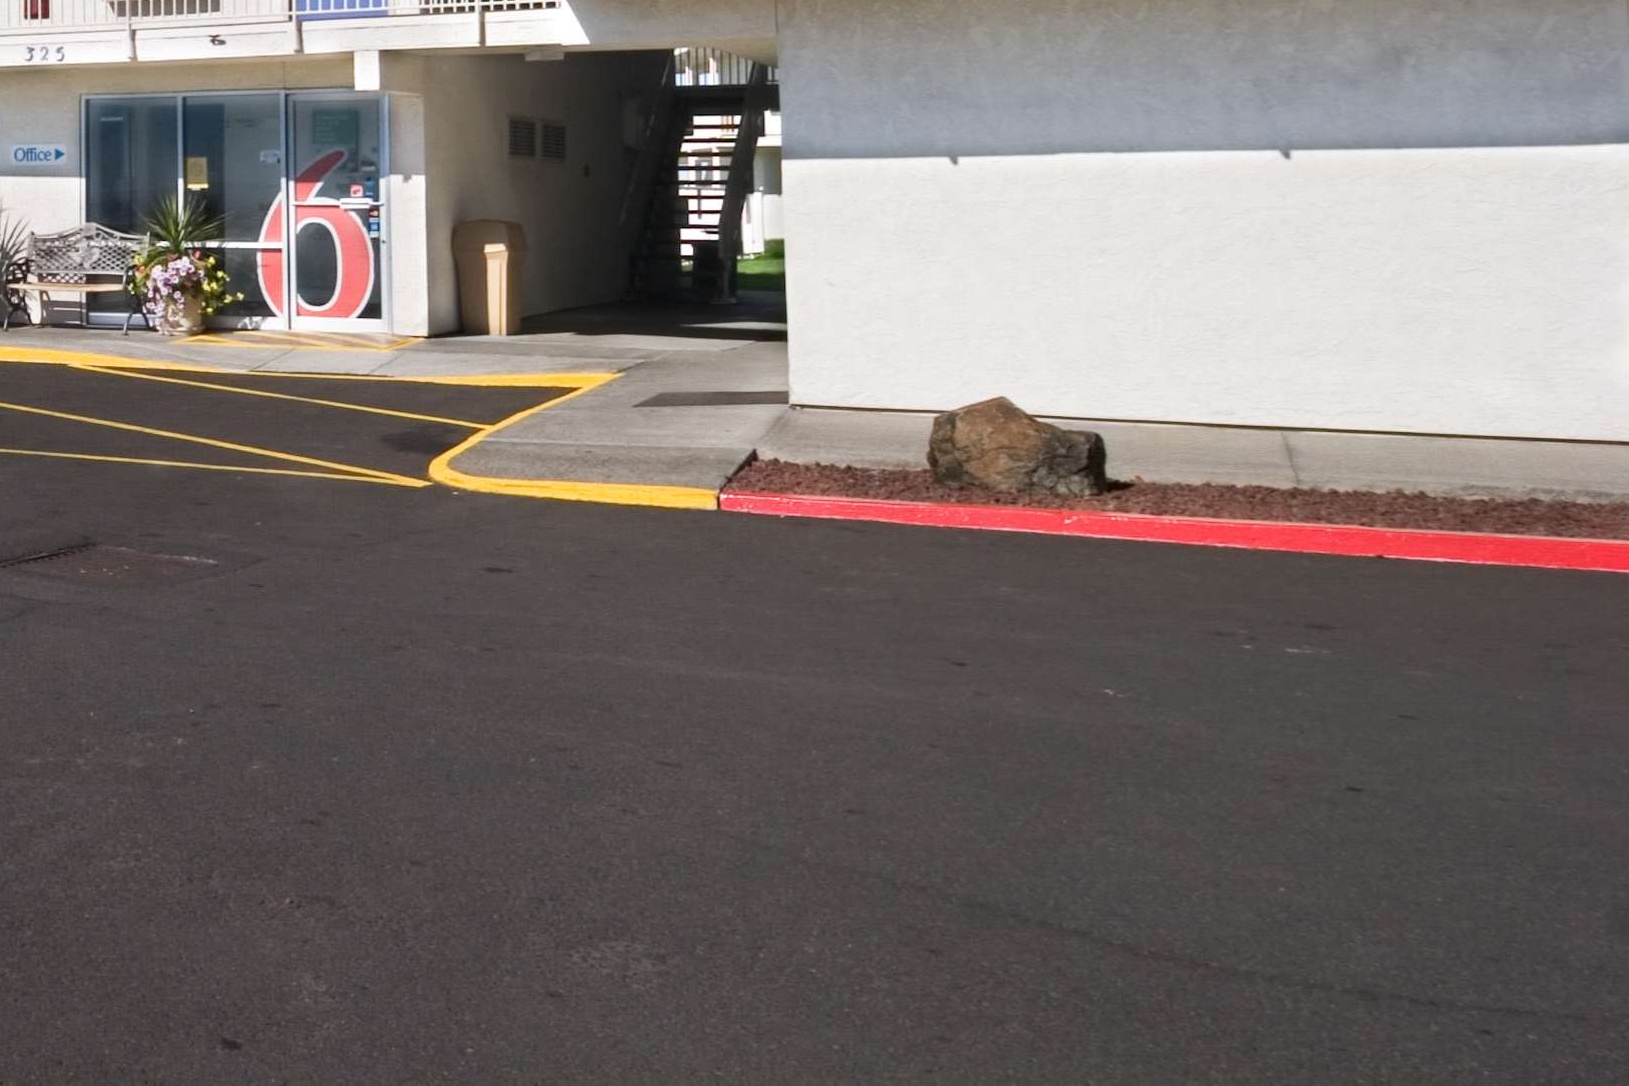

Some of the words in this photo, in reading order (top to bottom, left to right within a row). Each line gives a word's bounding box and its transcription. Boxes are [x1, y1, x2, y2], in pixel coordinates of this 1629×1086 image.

[24, 46, 66, 63] 325
[13, 146, 53, 163] Office
[256, 148, 375, 320] 6
